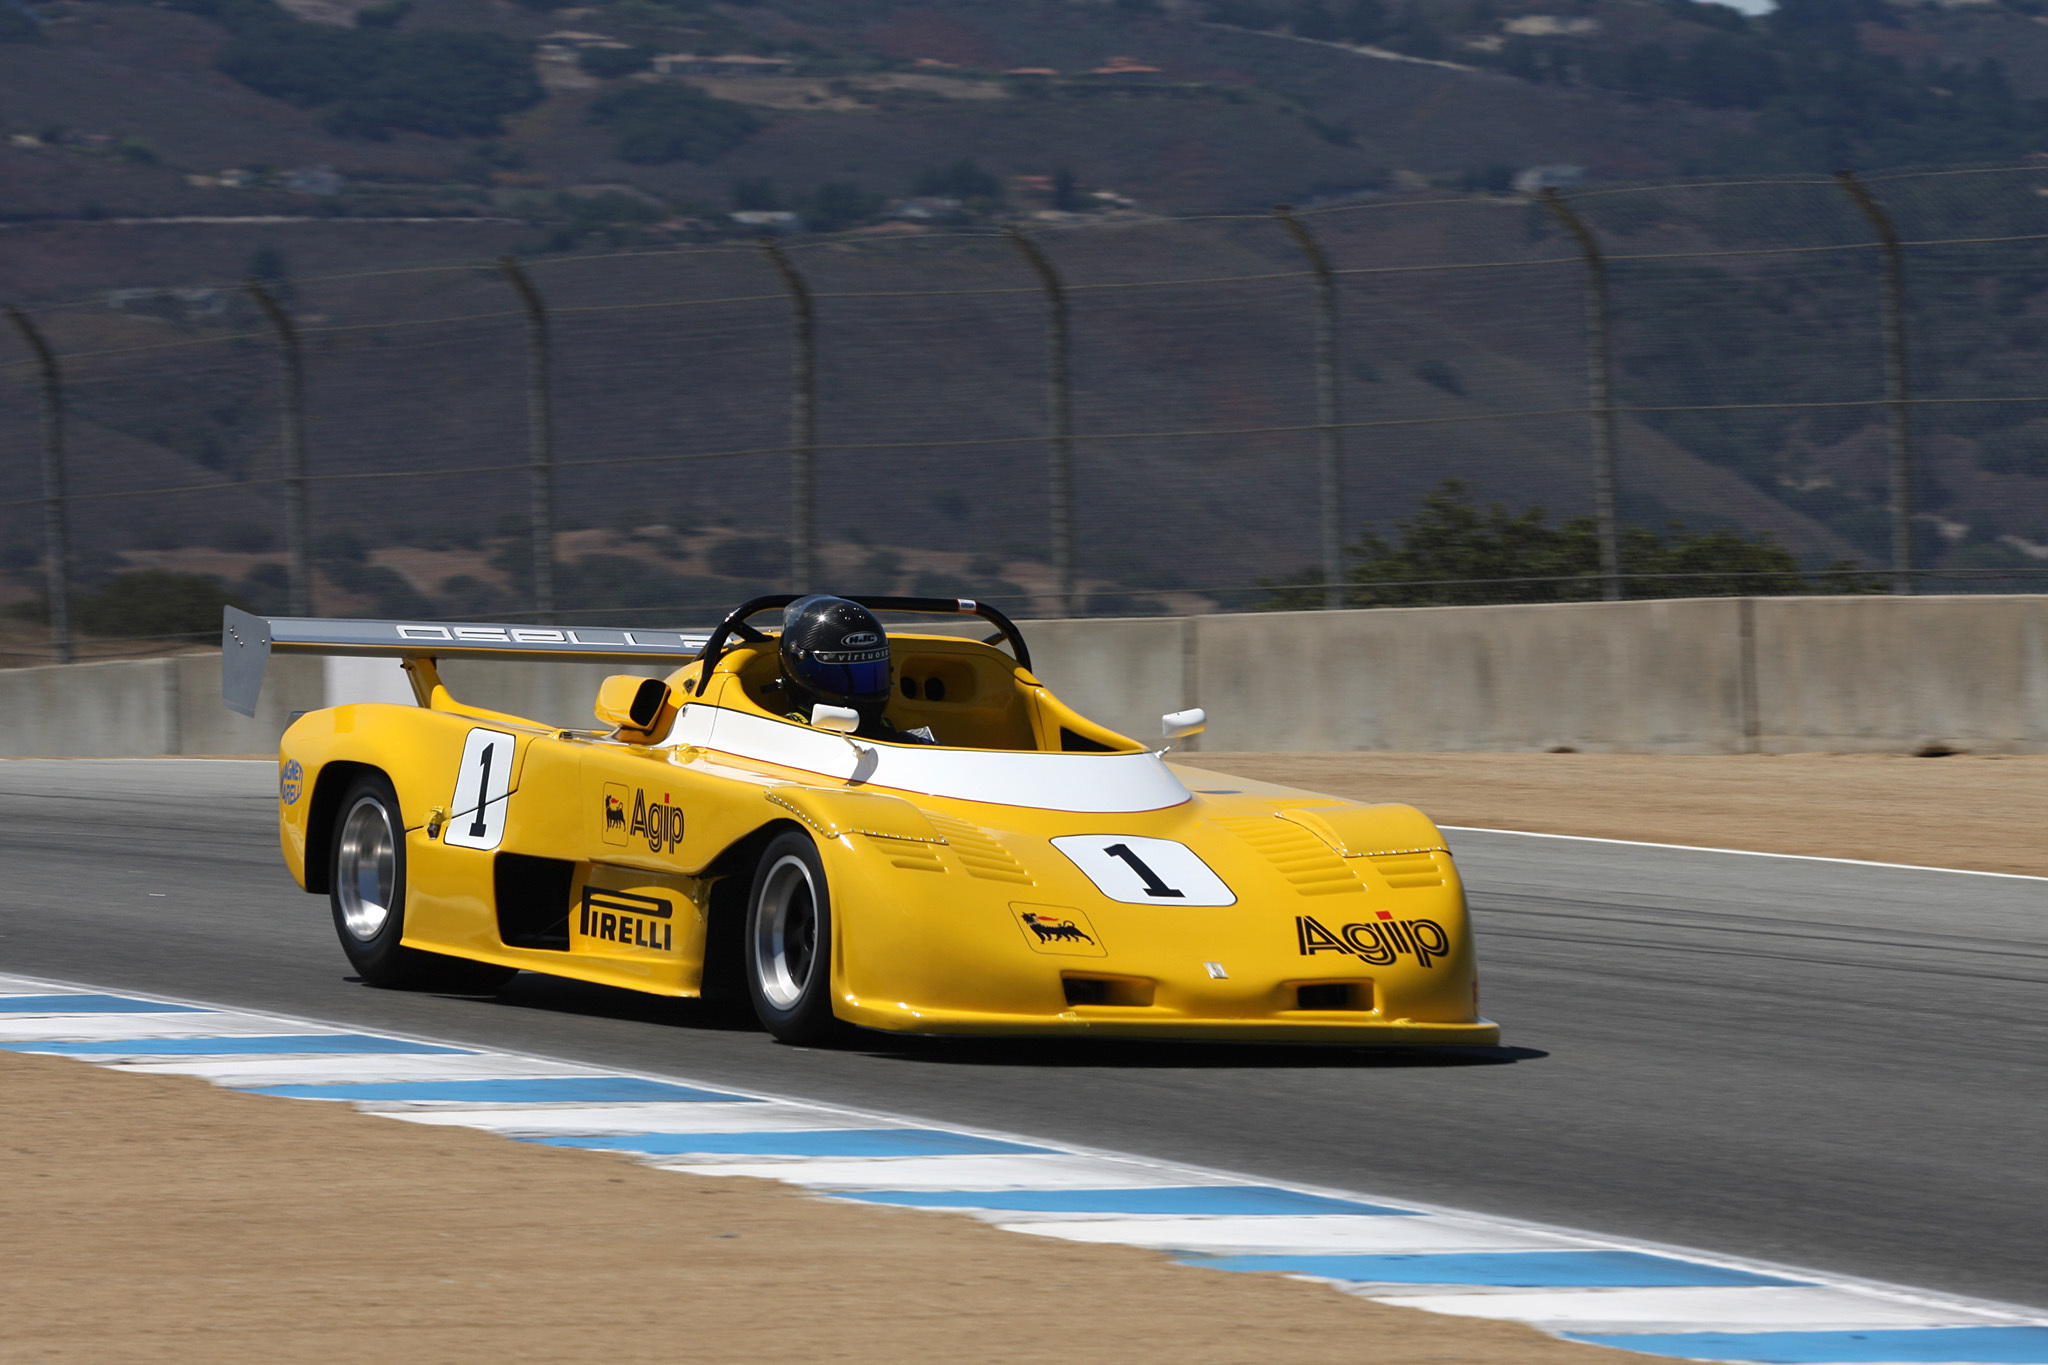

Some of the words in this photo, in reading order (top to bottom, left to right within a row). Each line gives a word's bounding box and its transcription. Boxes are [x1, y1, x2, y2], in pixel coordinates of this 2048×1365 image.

[469, 743, 494, 837] 1
[630, 788, 685, 854] Agip
[1103, 844, 1185, 897] 1
[580, 885, 673, 951] PIRELLI
[1295, 910, 1449, 968] Agip
